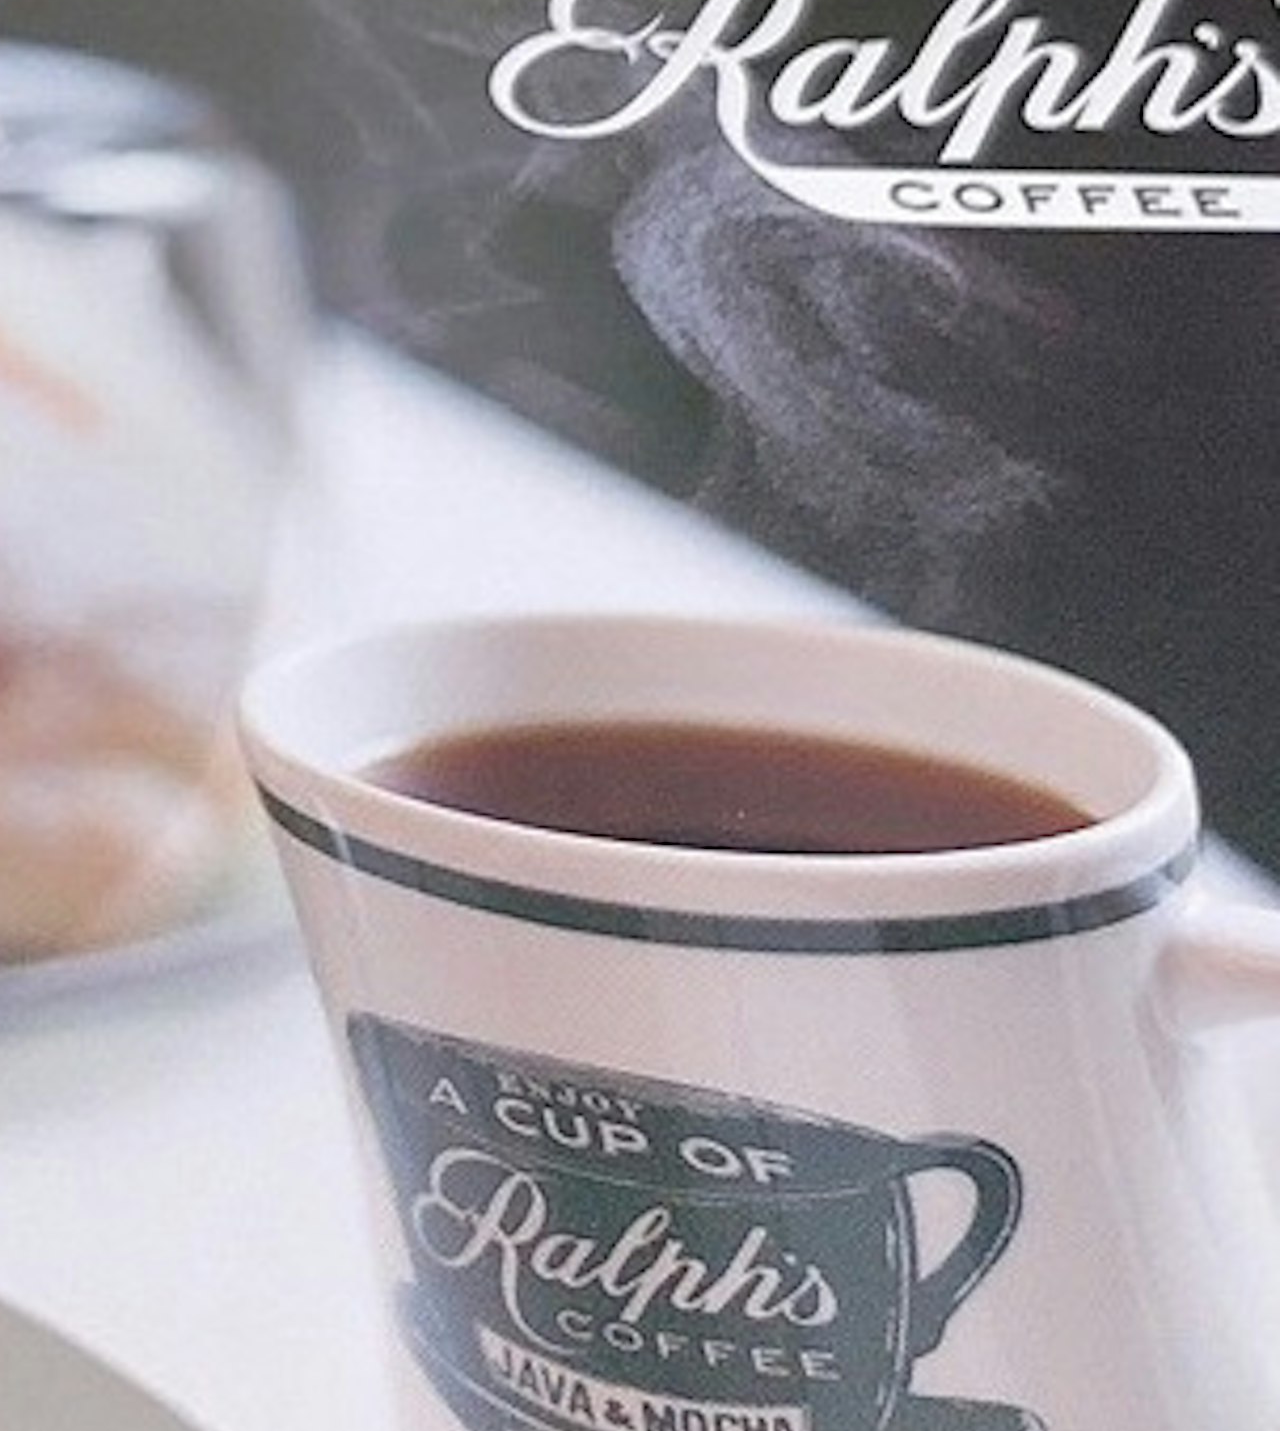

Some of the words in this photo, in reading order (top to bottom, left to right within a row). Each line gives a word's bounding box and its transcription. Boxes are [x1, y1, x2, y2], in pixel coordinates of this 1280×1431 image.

[889, 181, 1241, 219] COFFEE
[430, 1077, 467, 1114] A
[494, 1098, 649, 1155] CUP
[680, 1137, 796, 1183] OF
[496, 1072, 643, 1120] ENJOY
[414, 1147, 837, 1355] Ralph's
[557, 1309, 839, 1380] COFFEE
[500, 1348, 595, 1424] JAVA
[604, 1398, 634, 1430] &
